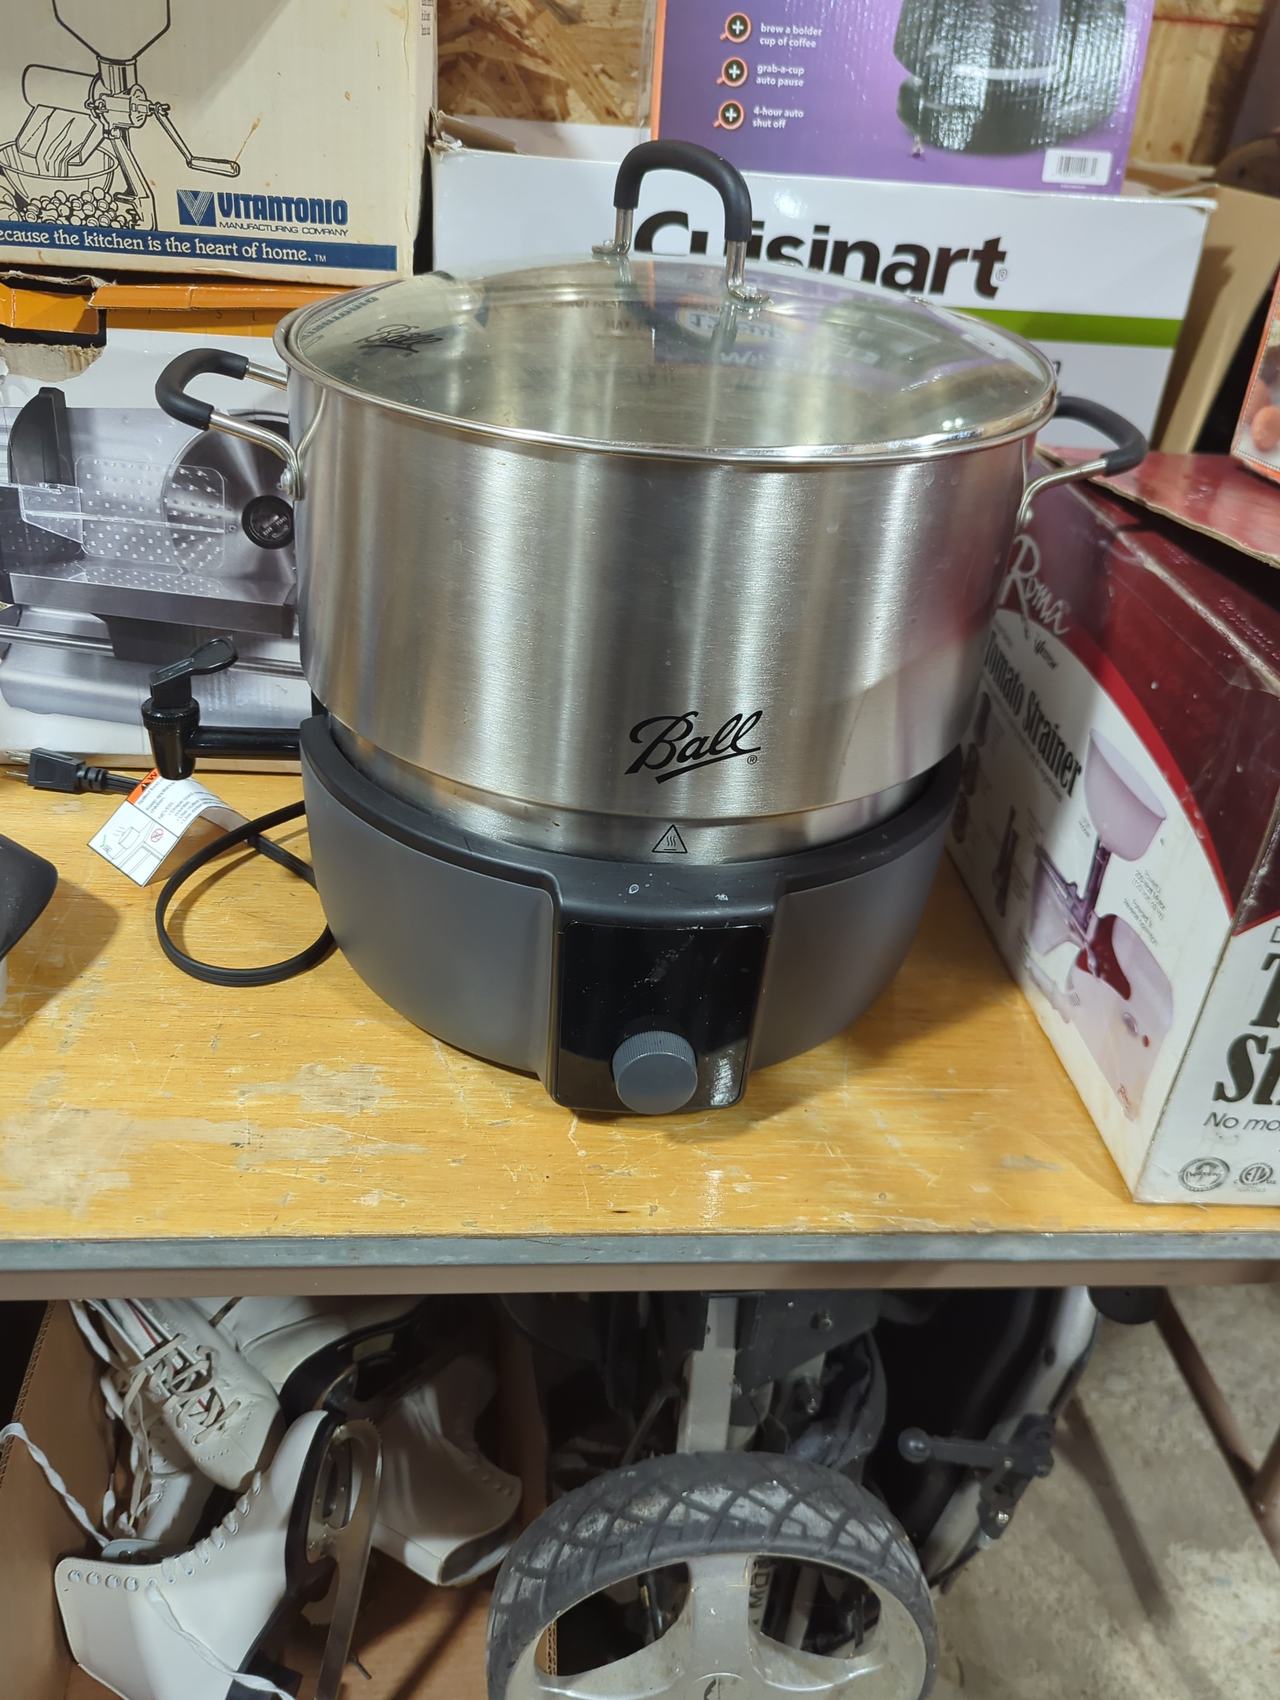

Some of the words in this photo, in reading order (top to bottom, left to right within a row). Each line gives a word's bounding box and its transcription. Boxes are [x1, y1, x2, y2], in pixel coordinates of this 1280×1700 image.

[761, 22, 785, 34] brew
[792, 24, 822, 36] bolder
[759, 38, 776, 47] cup
[778, 37, 788, 46] of
[789, 37, 817, 48] coffee
[757, 64, 805, 77] grab-a-cup
[756, 76, 776, 86] auto
[777, 77, 804, 88] pause
[753, 106, 782, 117] 4-hour
[784, 108, 804, 118] auto
[752, 118, 772, 128] shut
[773, 119, 786, 128] off
[217, 191, 348, 226] VITANTONIO
[219, 221, 298, 234] MANUFACTURING
[301, 227, 349, 237] COMPANY
[54, 229, 80, 246] the
[84, 230, 144, 251] kitchen
[149, 237, 161, 251] is
[165, 237, 191, 253] the
[194, 238, 239, 257] heart
[242, 242, 259, 258] of
[262, 243, 312, 263] home.
[1000, 534, 1071, 640] Roma
[624, 710, 764, 784] Ball
[1022, 690, 1082, 799] Strainer
[1203, 1112, 1239, 1129] No
